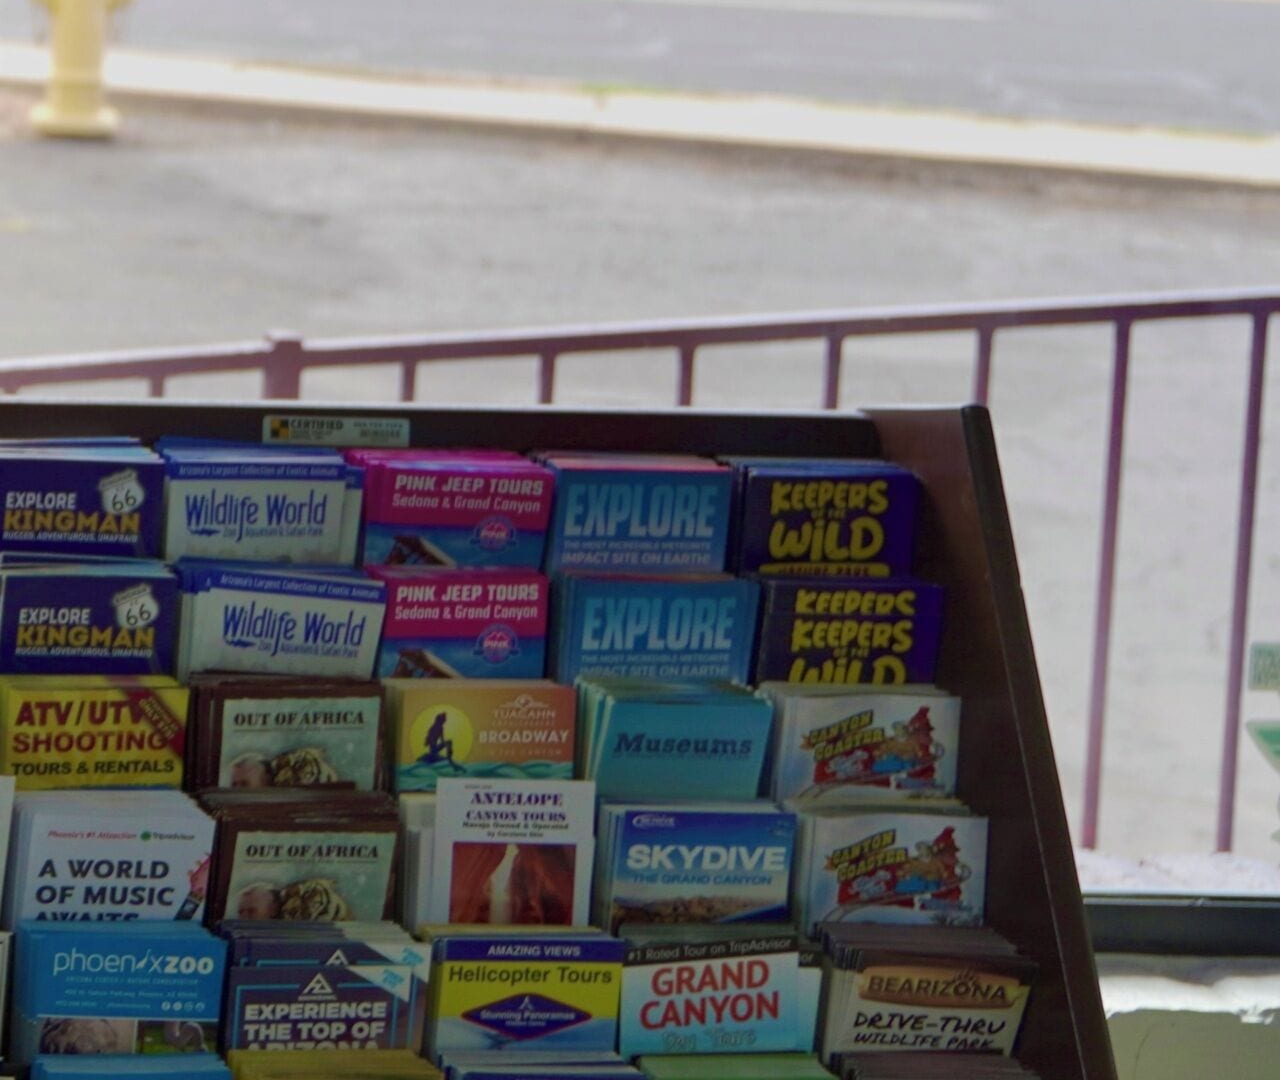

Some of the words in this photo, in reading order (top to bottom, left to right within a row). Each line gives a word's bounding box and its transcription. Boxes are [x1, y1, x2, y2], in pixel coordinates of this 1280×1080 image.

[394, 474, 437, 491] PINK
[441, 476, 485, 493] JEEP
[489, 478, 544, 496] TOURS
[5, 491, 77, 509] EXPLORE
[111, 489, 137, 512] 66
[392, 493, 439, 508] Sedona
[442, 496, 450, 508] &
[454, 495, 490, 510] Grand
[493, 496, 541, 514] Canyon
[771, 479, 889, 515] KEEPERS
[3, 509, 140, 533] KINGMAN
[185, 488, 259, 542] Wildlife
[266, 489, 327, 526] World
[563, 484, 718, 537] EXPLORE
[561, 552, 610, 564] IMPACT
[612, 552, 640, 564] SITE
[641, 552, 660, 564] ON
[396, 584, 437, 602] PINK
[441, 584, 483, 602] JEEP
[488, 583, 539, 602] TOURS
[19, 608, 91, 624] EXPLORE
[125, 604, 151, 626] 66
[394, 605, 440, 620] Sedona
[443, 606, 451, 619] &
[454, 605, 490, 620] Grand
[493, 605, 538, 621] Canyon
[581, 597, 737, 651] EXPLORE
[16, 625, 155, 647] KINGMAN
[223, 601, 296, 656] Wildlife
[304, 611, 366, 646] World
[791, 619, 914, 653] KEEPERS
[234, 713, 270, 726] OUT
[274, 712, 297, 725] OF
[299, 710, 364, 725] AFRICA
[810, 709, 873, 745] CANYON
[13, 731, 168, 753] SHOOTING
[479, 730, 569, 744] BROADWAY
[614, 732, 752, 755] Museums
[814, 728, 885, 762] COASTER
[12, 762, 71, 775] TOURS
[76, 762, 88, 774] &
[94, 760, 174, 774] RENTALS
[471, 792, 563, 806] ANTELOPE
[466, 810, 518, 820] CANYON
[522, 811, 567, 822] TOURS
[245, 845, 283, 858] OUT
[288, 845, 310, 858] OF
[312, 845, 378, 858] AFRICA
[626, 844, 787, 870] SKYDIVE
[832, 829, 896, 865] CANYON
[38, 859, 57, 878] A
[68, 859, 170, 879] WORLD
[838, 847, 908, 881] COASTER
[633, 874, 658, 883] THE
[661, 874, 710, 884] GRAND
[713, 875, 772, 885] CANYON
[35, 885, 75, 904] OF
[83, 886, 175, 906] MUSIC
[487, 945, 540, 956] AMAZING
[543, 945, 582, 956] VIEWS
[628, 950, 641, 960] #1
[646, 948, 679, 960] Rated
[684, 946, 706, 957] Tour
[710, 944, 725, 954] on
[730, 938, 792, 954] TripAdvisor
[448, 965, 550, 986] Helicopter
[557, 966, 612, 983] Tours
[651, 959, 769, 996] GRAND
[868, 975, 1007, 1002] BEARIZONA
[244, 1002, 388, 1020] EXPERIENCE
[480, 1010, 522, 1020] Stunning
[640, 991, 779, 1030] CANYON
[244, 1023, 292, 1041] THE
[297, 1022, 347, 1040] TOP
[351, 1021, 386, 1039] OF
[854, 1012, 1005, 1035] DRIVE-THRU
[854, 1032, 941, 1047] WILDLIFE
[946, 1037, 993, 1050] PARK
